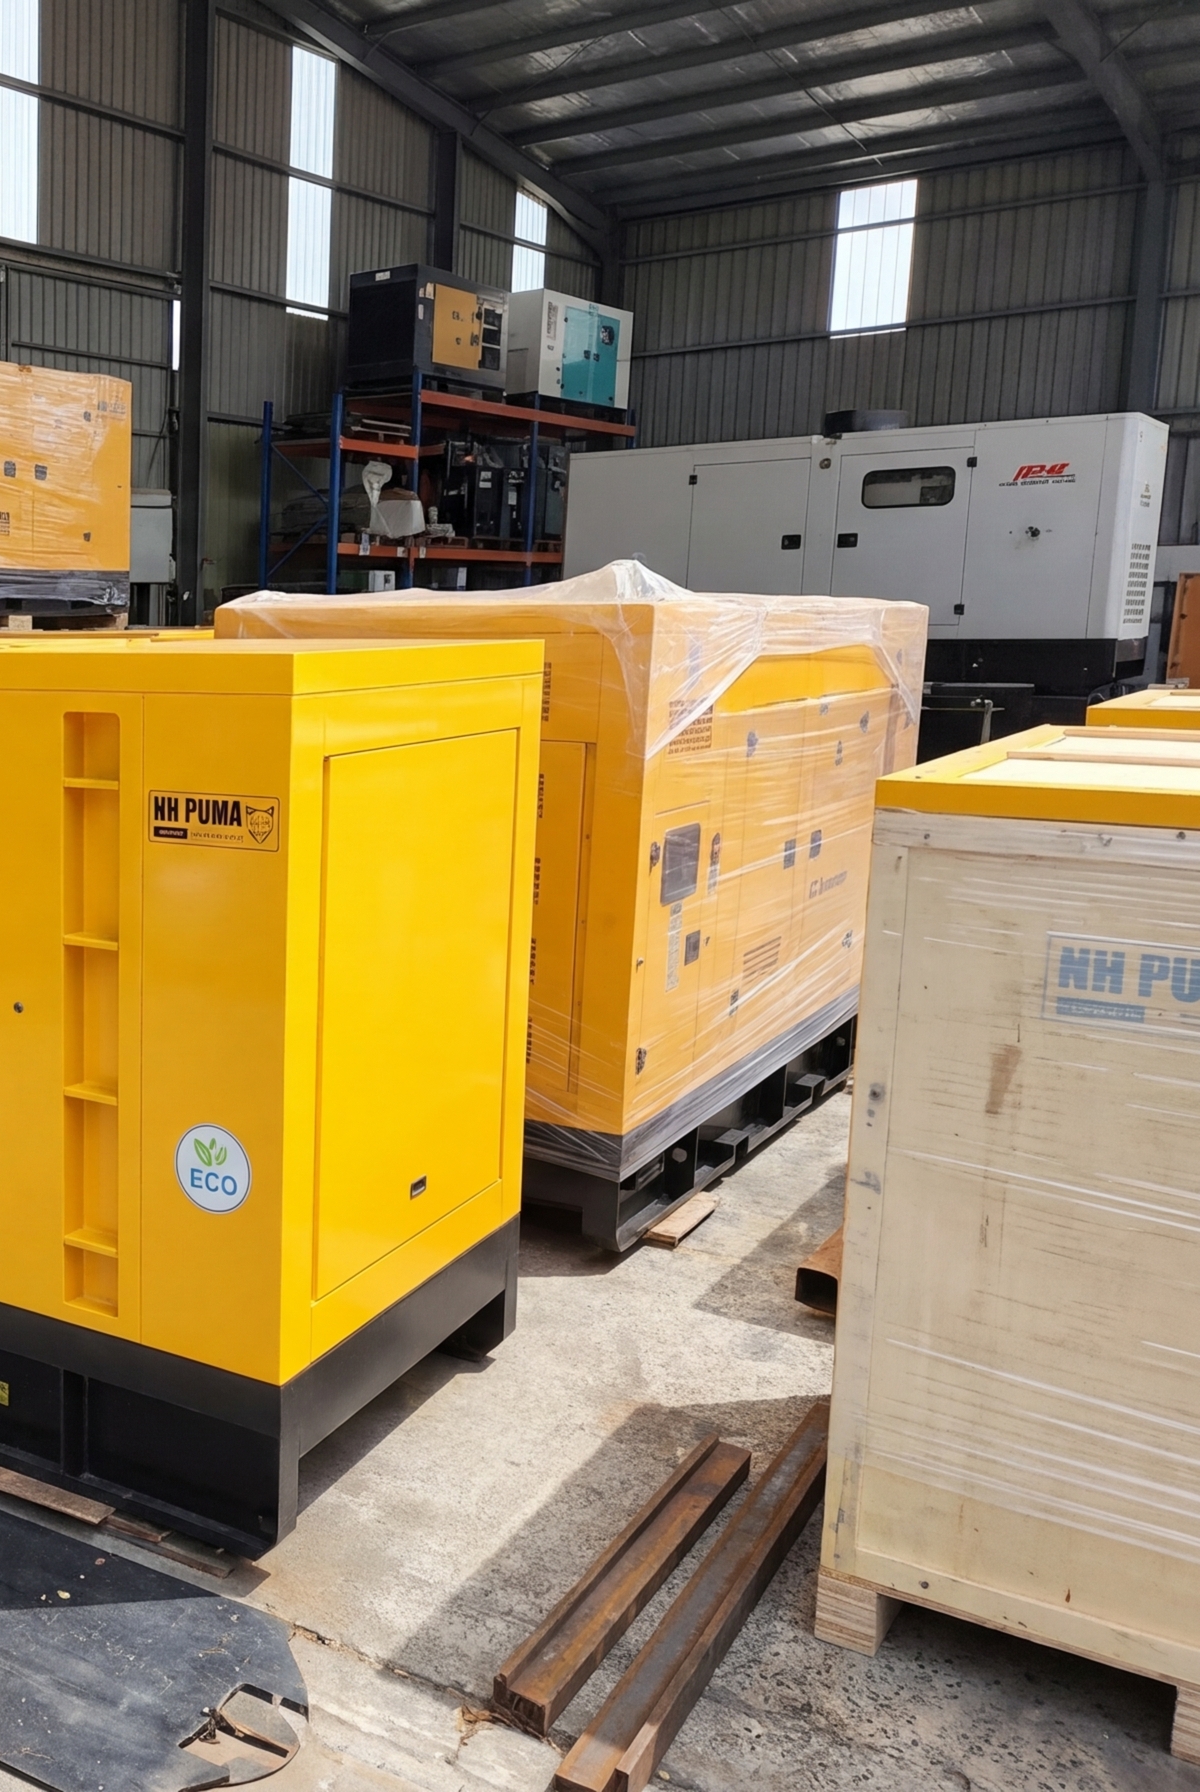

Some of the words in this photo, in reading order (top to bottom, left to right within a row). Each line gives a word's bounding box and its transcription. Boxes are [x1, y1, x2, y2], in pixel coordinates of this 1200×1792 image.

[153, 795, 179, 823] NH
[185, 797, 243, 828] PUMA
[1058, 946, 1126, 995] NH
[190, 1167, 238, 1197] ECO
